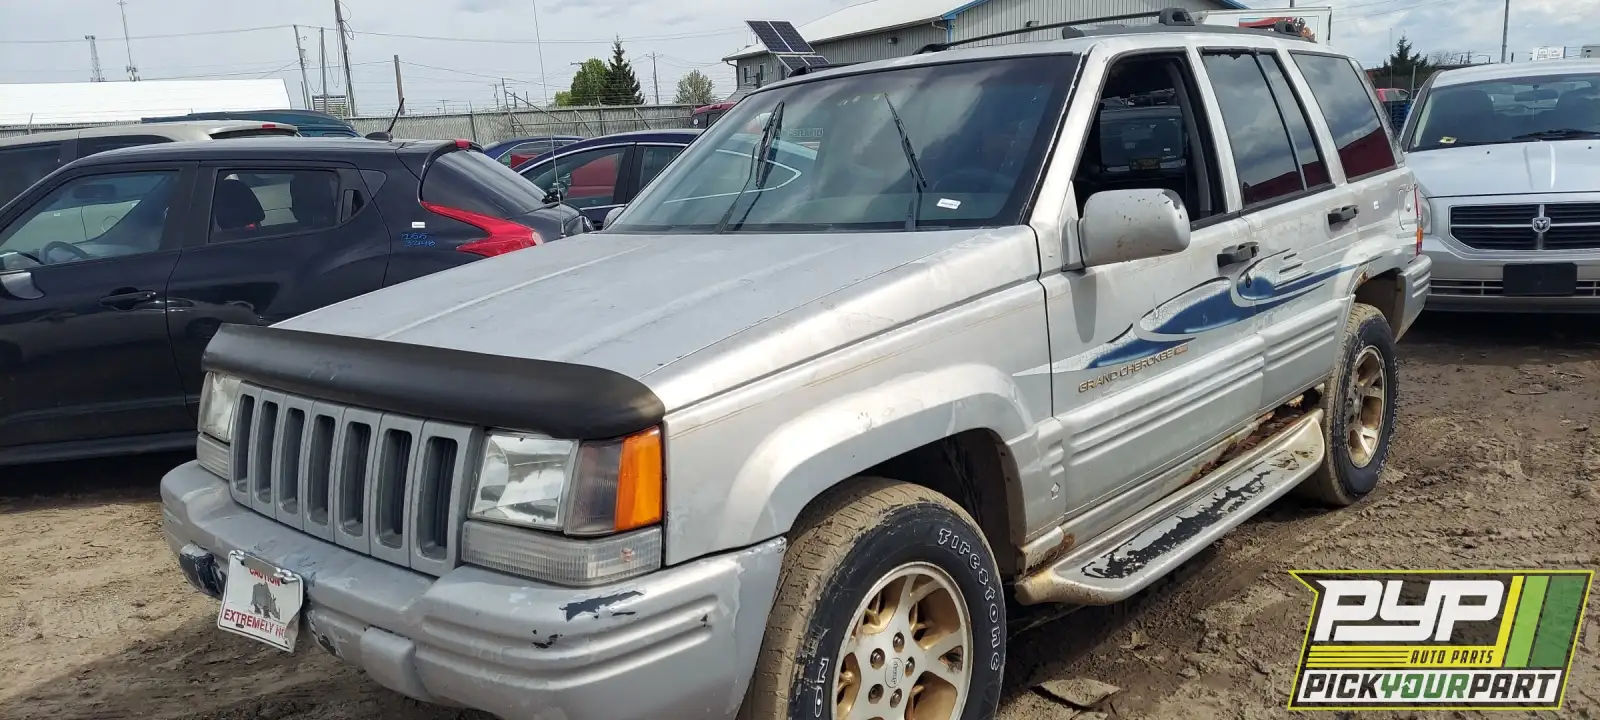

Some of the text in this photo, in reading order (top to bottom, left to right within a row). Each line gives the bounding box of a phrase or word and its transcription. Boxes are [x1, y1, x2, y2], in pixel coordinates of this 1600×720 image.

[1078, 349, 1173, 393] GRAND CHEROKEE
[223, 608, 275, 634] EXTREMELY
[937, 527, 1001, 671] Firestone
